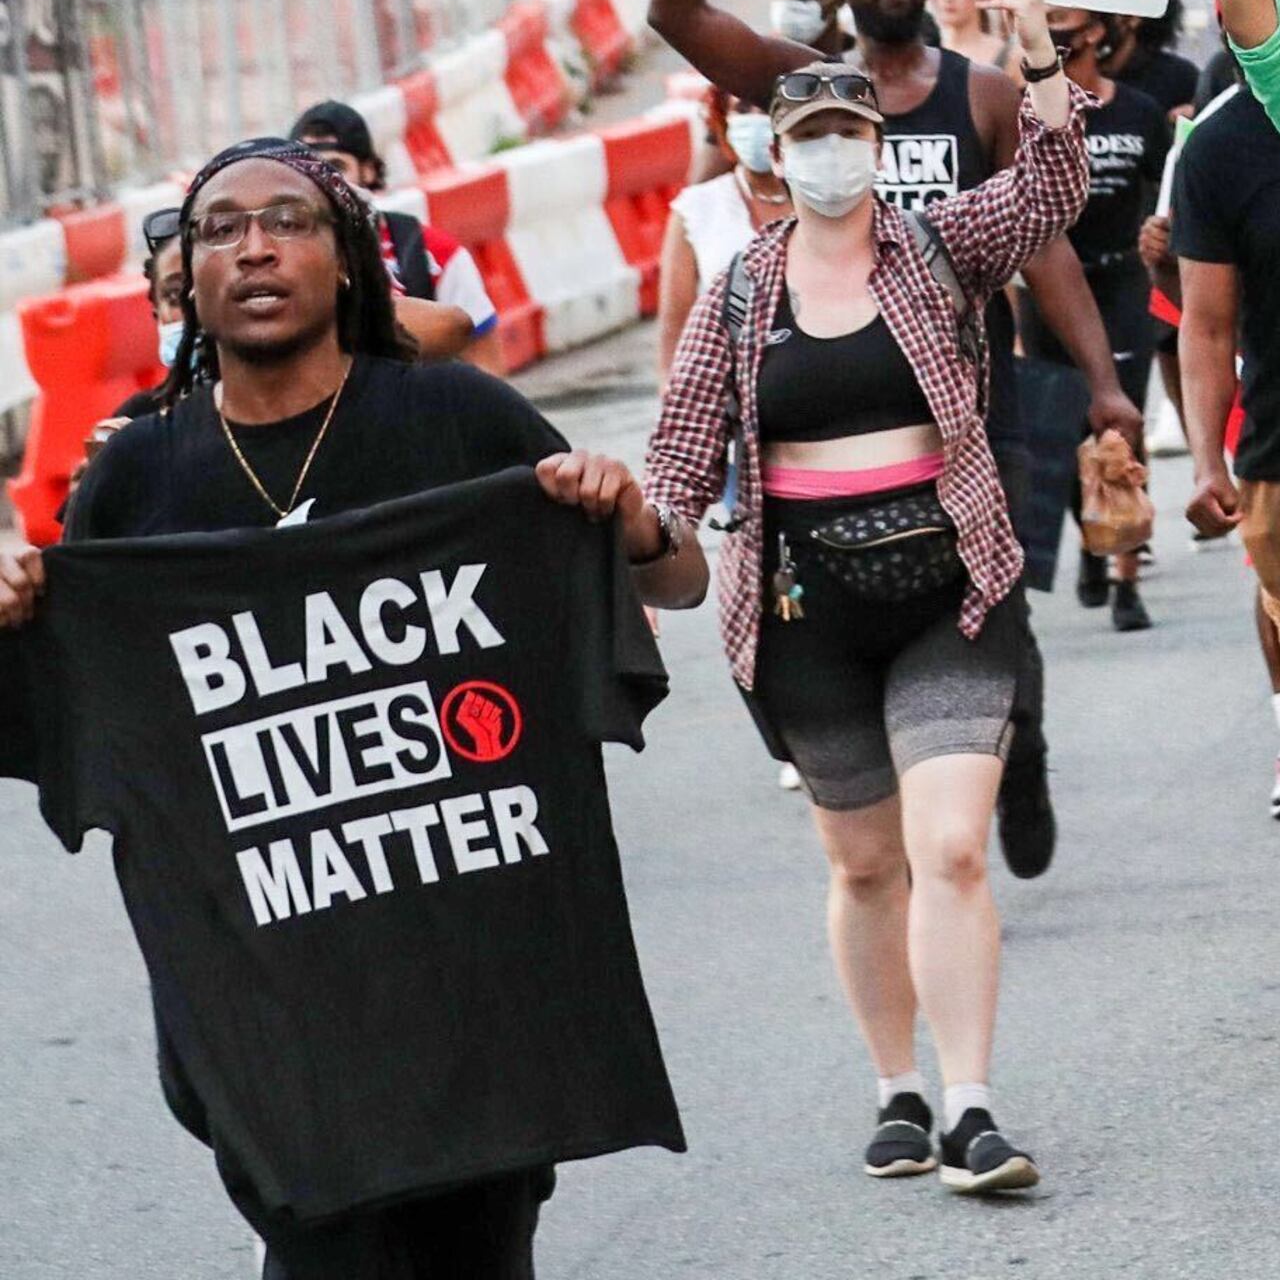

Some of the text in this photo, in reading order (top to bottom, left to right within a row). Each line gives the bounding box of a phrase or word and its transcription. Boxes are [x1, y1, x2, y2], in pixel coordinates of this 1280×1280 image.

[876, 140, 952, 184] ACK
[169, 563, 506, 717] BLACK
[209, 692, 443, 822] LIVES
[235, 784, 550, 927] MATTER
